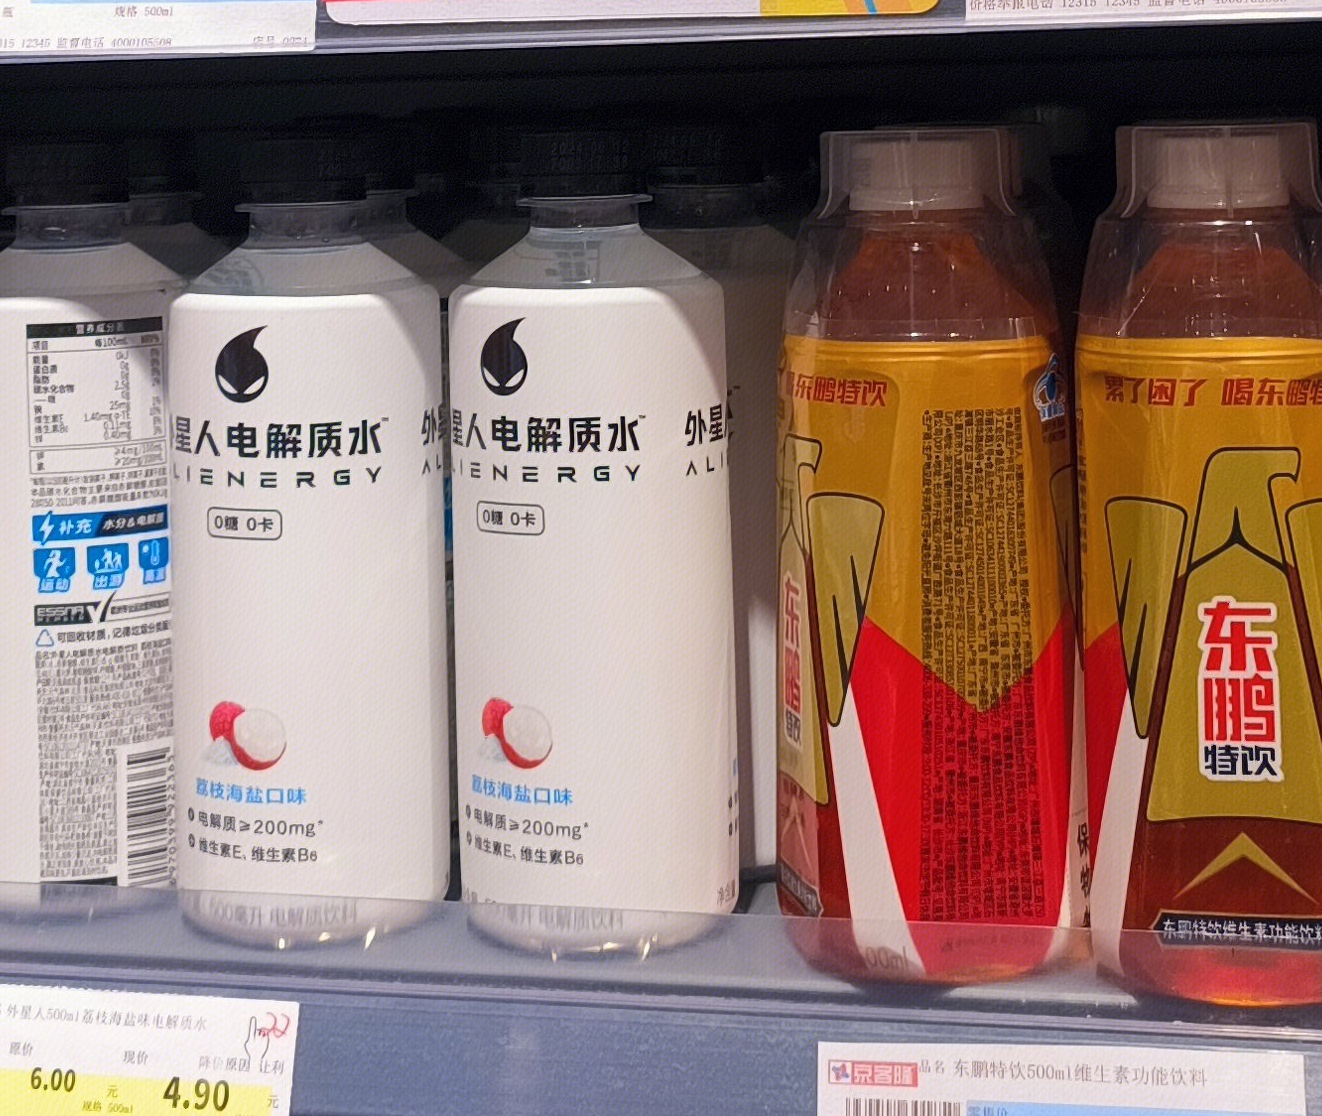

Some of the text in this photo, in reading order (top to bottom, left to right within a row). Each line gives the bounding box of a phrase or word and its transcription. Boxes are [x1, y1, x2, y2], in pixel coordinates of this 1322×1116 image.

[1105, 377, 1208, 407] 累了困了
[59, 518, 93, 535] 补充
[214, 514, 274, 534] 0糖 0卡
[510, 510, 537, 528] 0卡
[196, 775, 307, 807] 荔枝海盐口味
[471, 773, 574, 808] 荔枝海盐口味
[30, 1066, 76, 1094] 6.00
[953, 1058, 1208, 1088] 东鹏特饮500ml维生素功能饮料
[163, 1076, 230, 1112] 4.90
